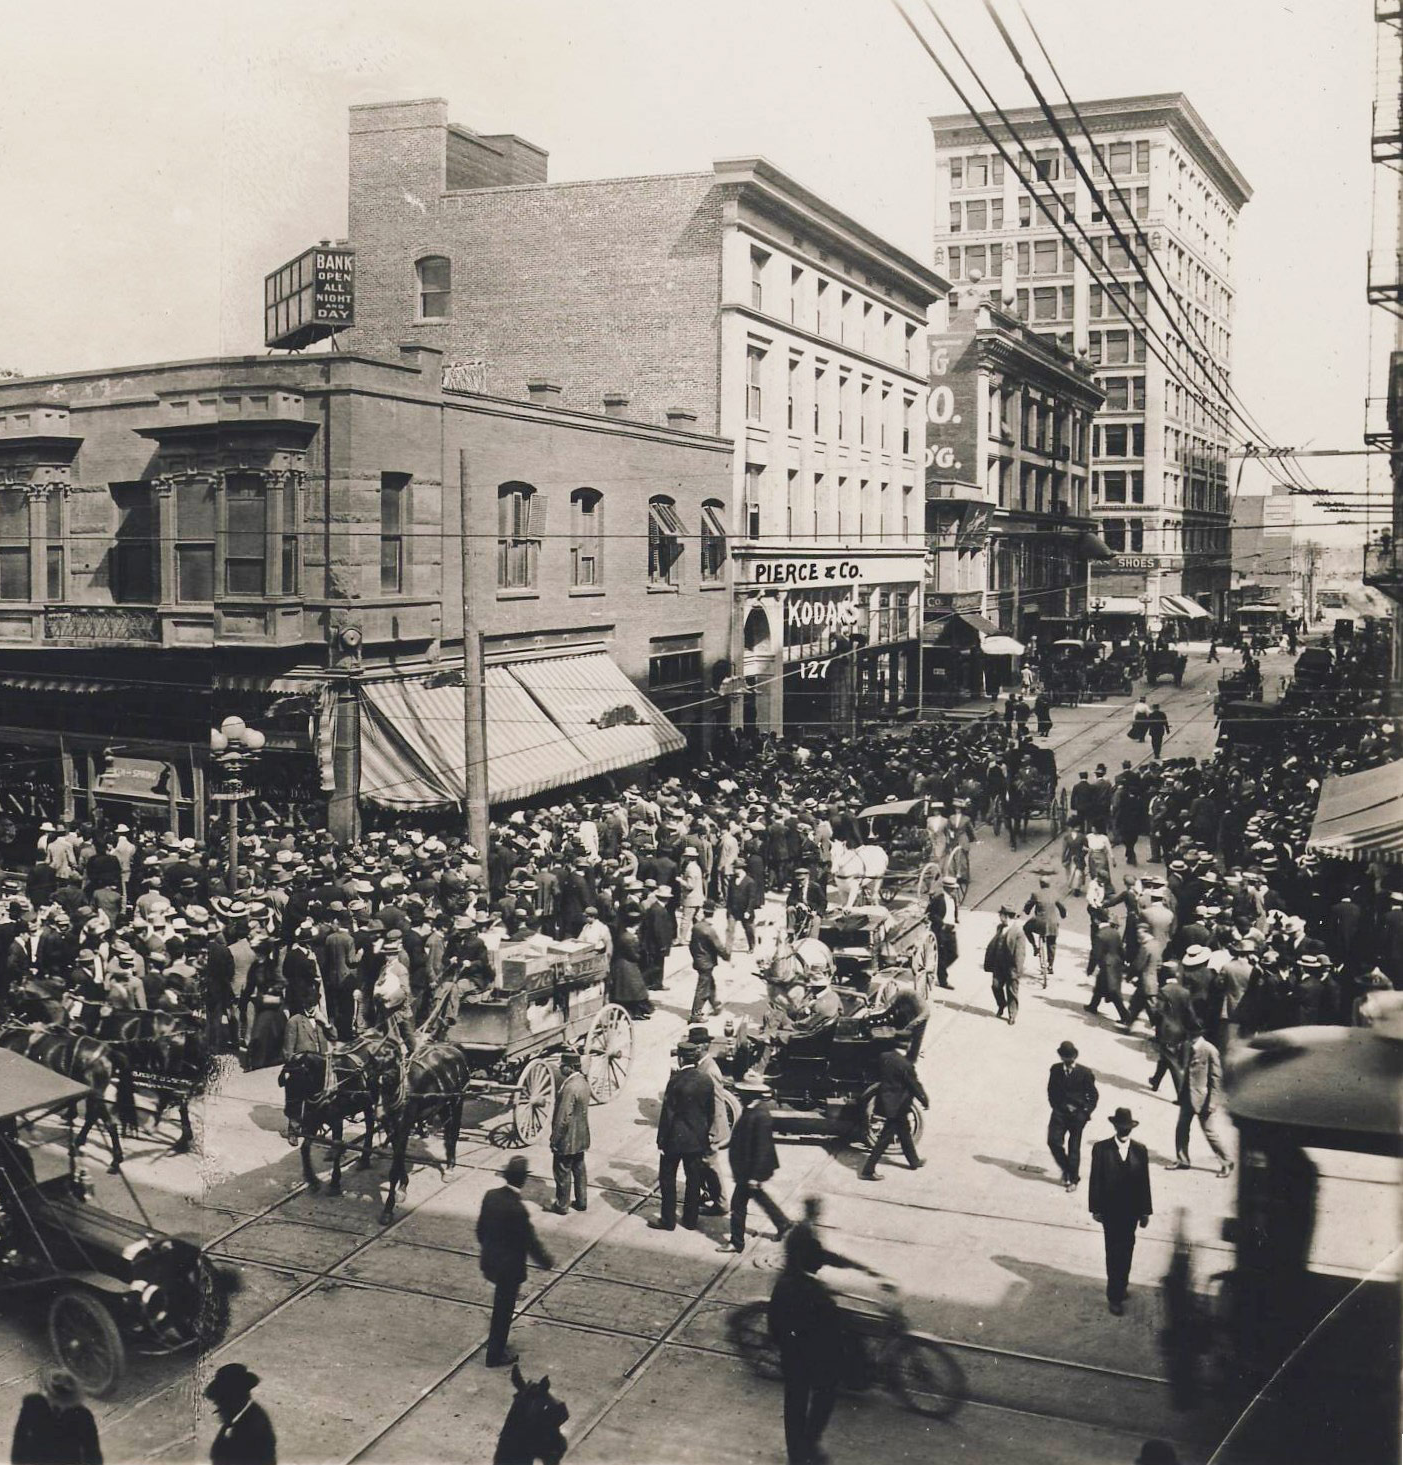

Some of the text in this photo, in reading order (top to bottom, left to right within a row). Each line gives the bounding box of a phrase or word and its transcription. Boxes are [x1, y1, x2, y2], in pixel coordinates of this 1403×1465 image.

[316, 254, 352, 271] BANK
[318, 272, 351, 282] OPEN
[324, 283, 345, 292] ALL
[316, 294, 352, 303] NIGHT
[318, 309, 349, 318] DAY
[1118, 558, 1155, 568] SHOES
[756, 563, 819, 584] PIERCE
[788, 599, 859, 628] KODAKS
[800, 659, 831, 679] 127
